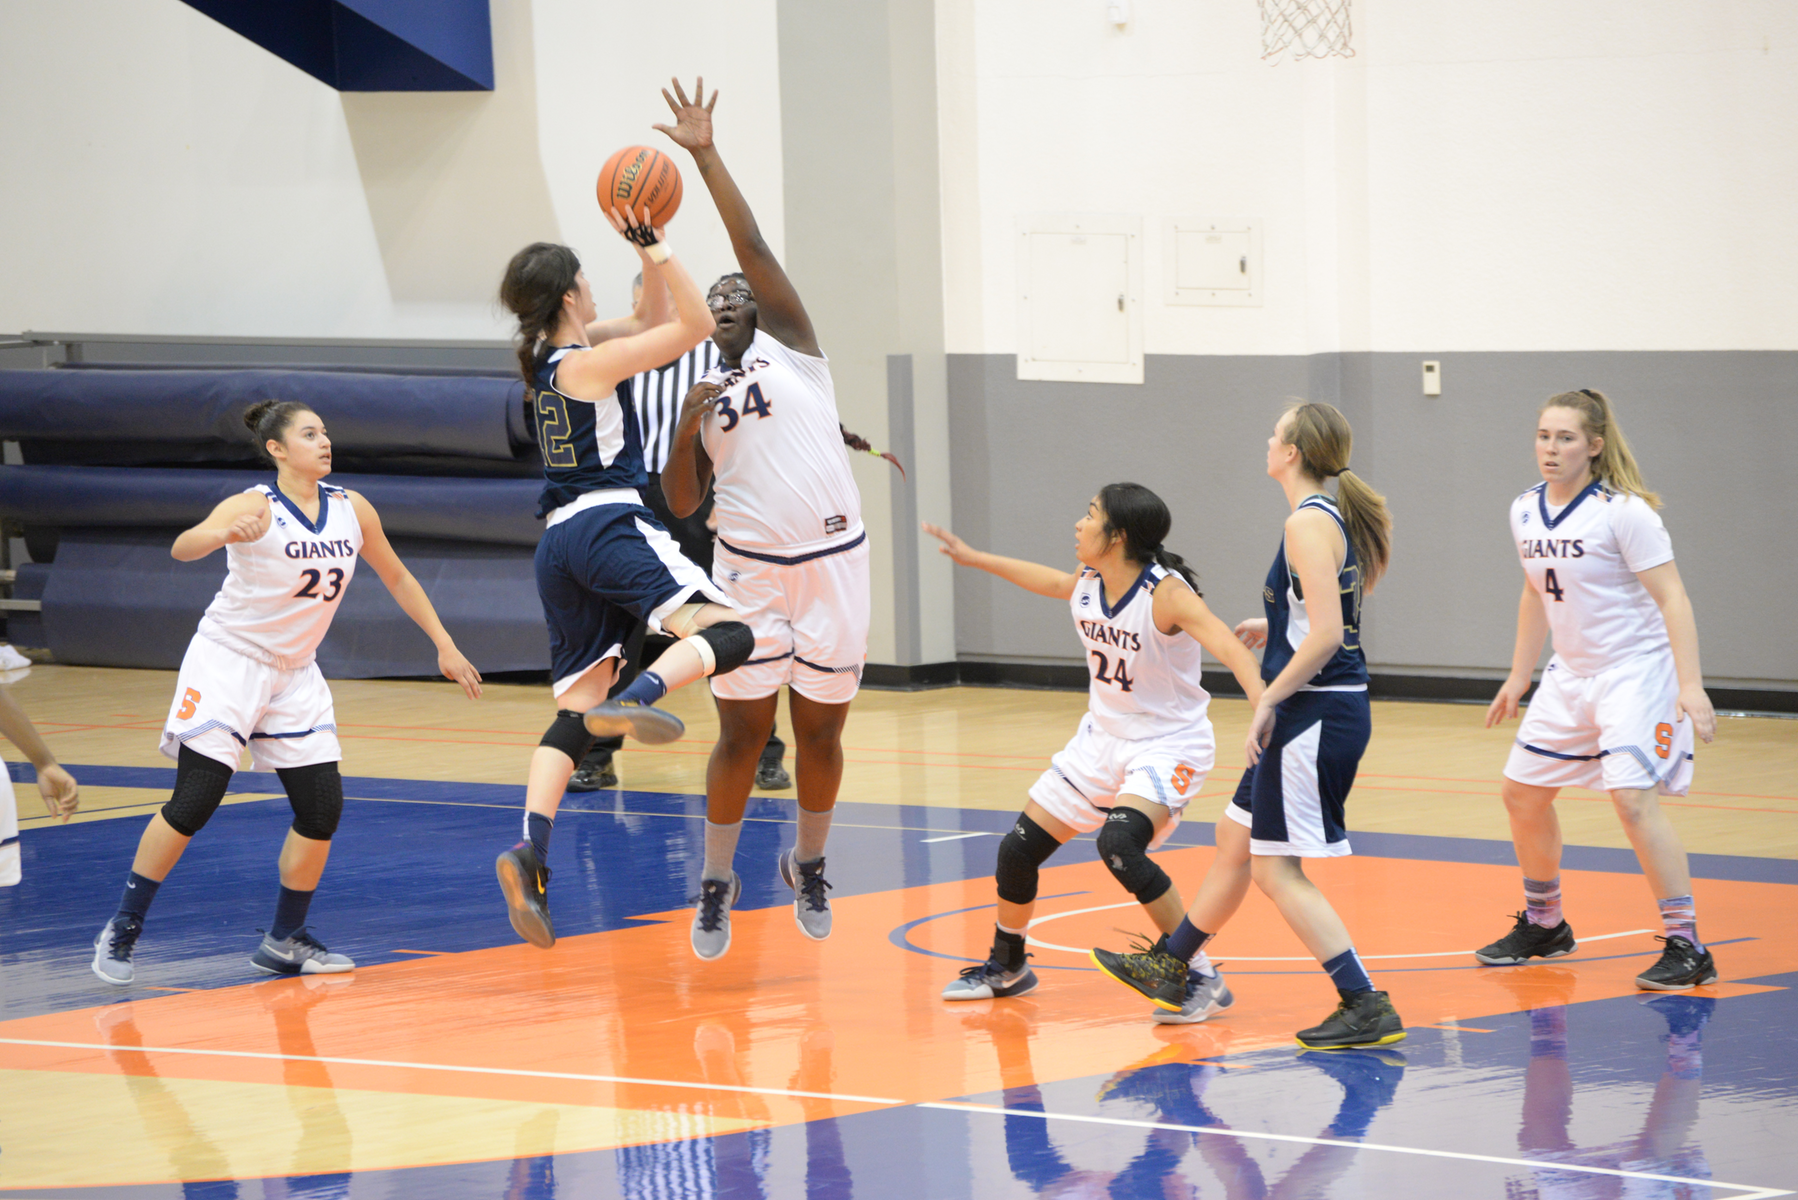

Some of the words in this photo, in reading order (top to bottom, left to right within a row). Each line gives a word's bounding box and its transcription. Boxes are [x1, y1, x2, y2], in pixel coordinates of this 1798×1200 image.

[616, 149, 654, 199] Wilson
[714, 381, 773, 434] 34
[532, 387, 578, 468] 2
[284, 538, 355, 560] GIANTS
[292, 567, 345, 603] 23
[1545, 567, 1565, 603] 4
[1080, 619, 1142, 653] GIANTS
[1091, 649, 1135, 693] 24
[1655, 721, 1674, 760] S
[1170, 763, 1197, 796] S
